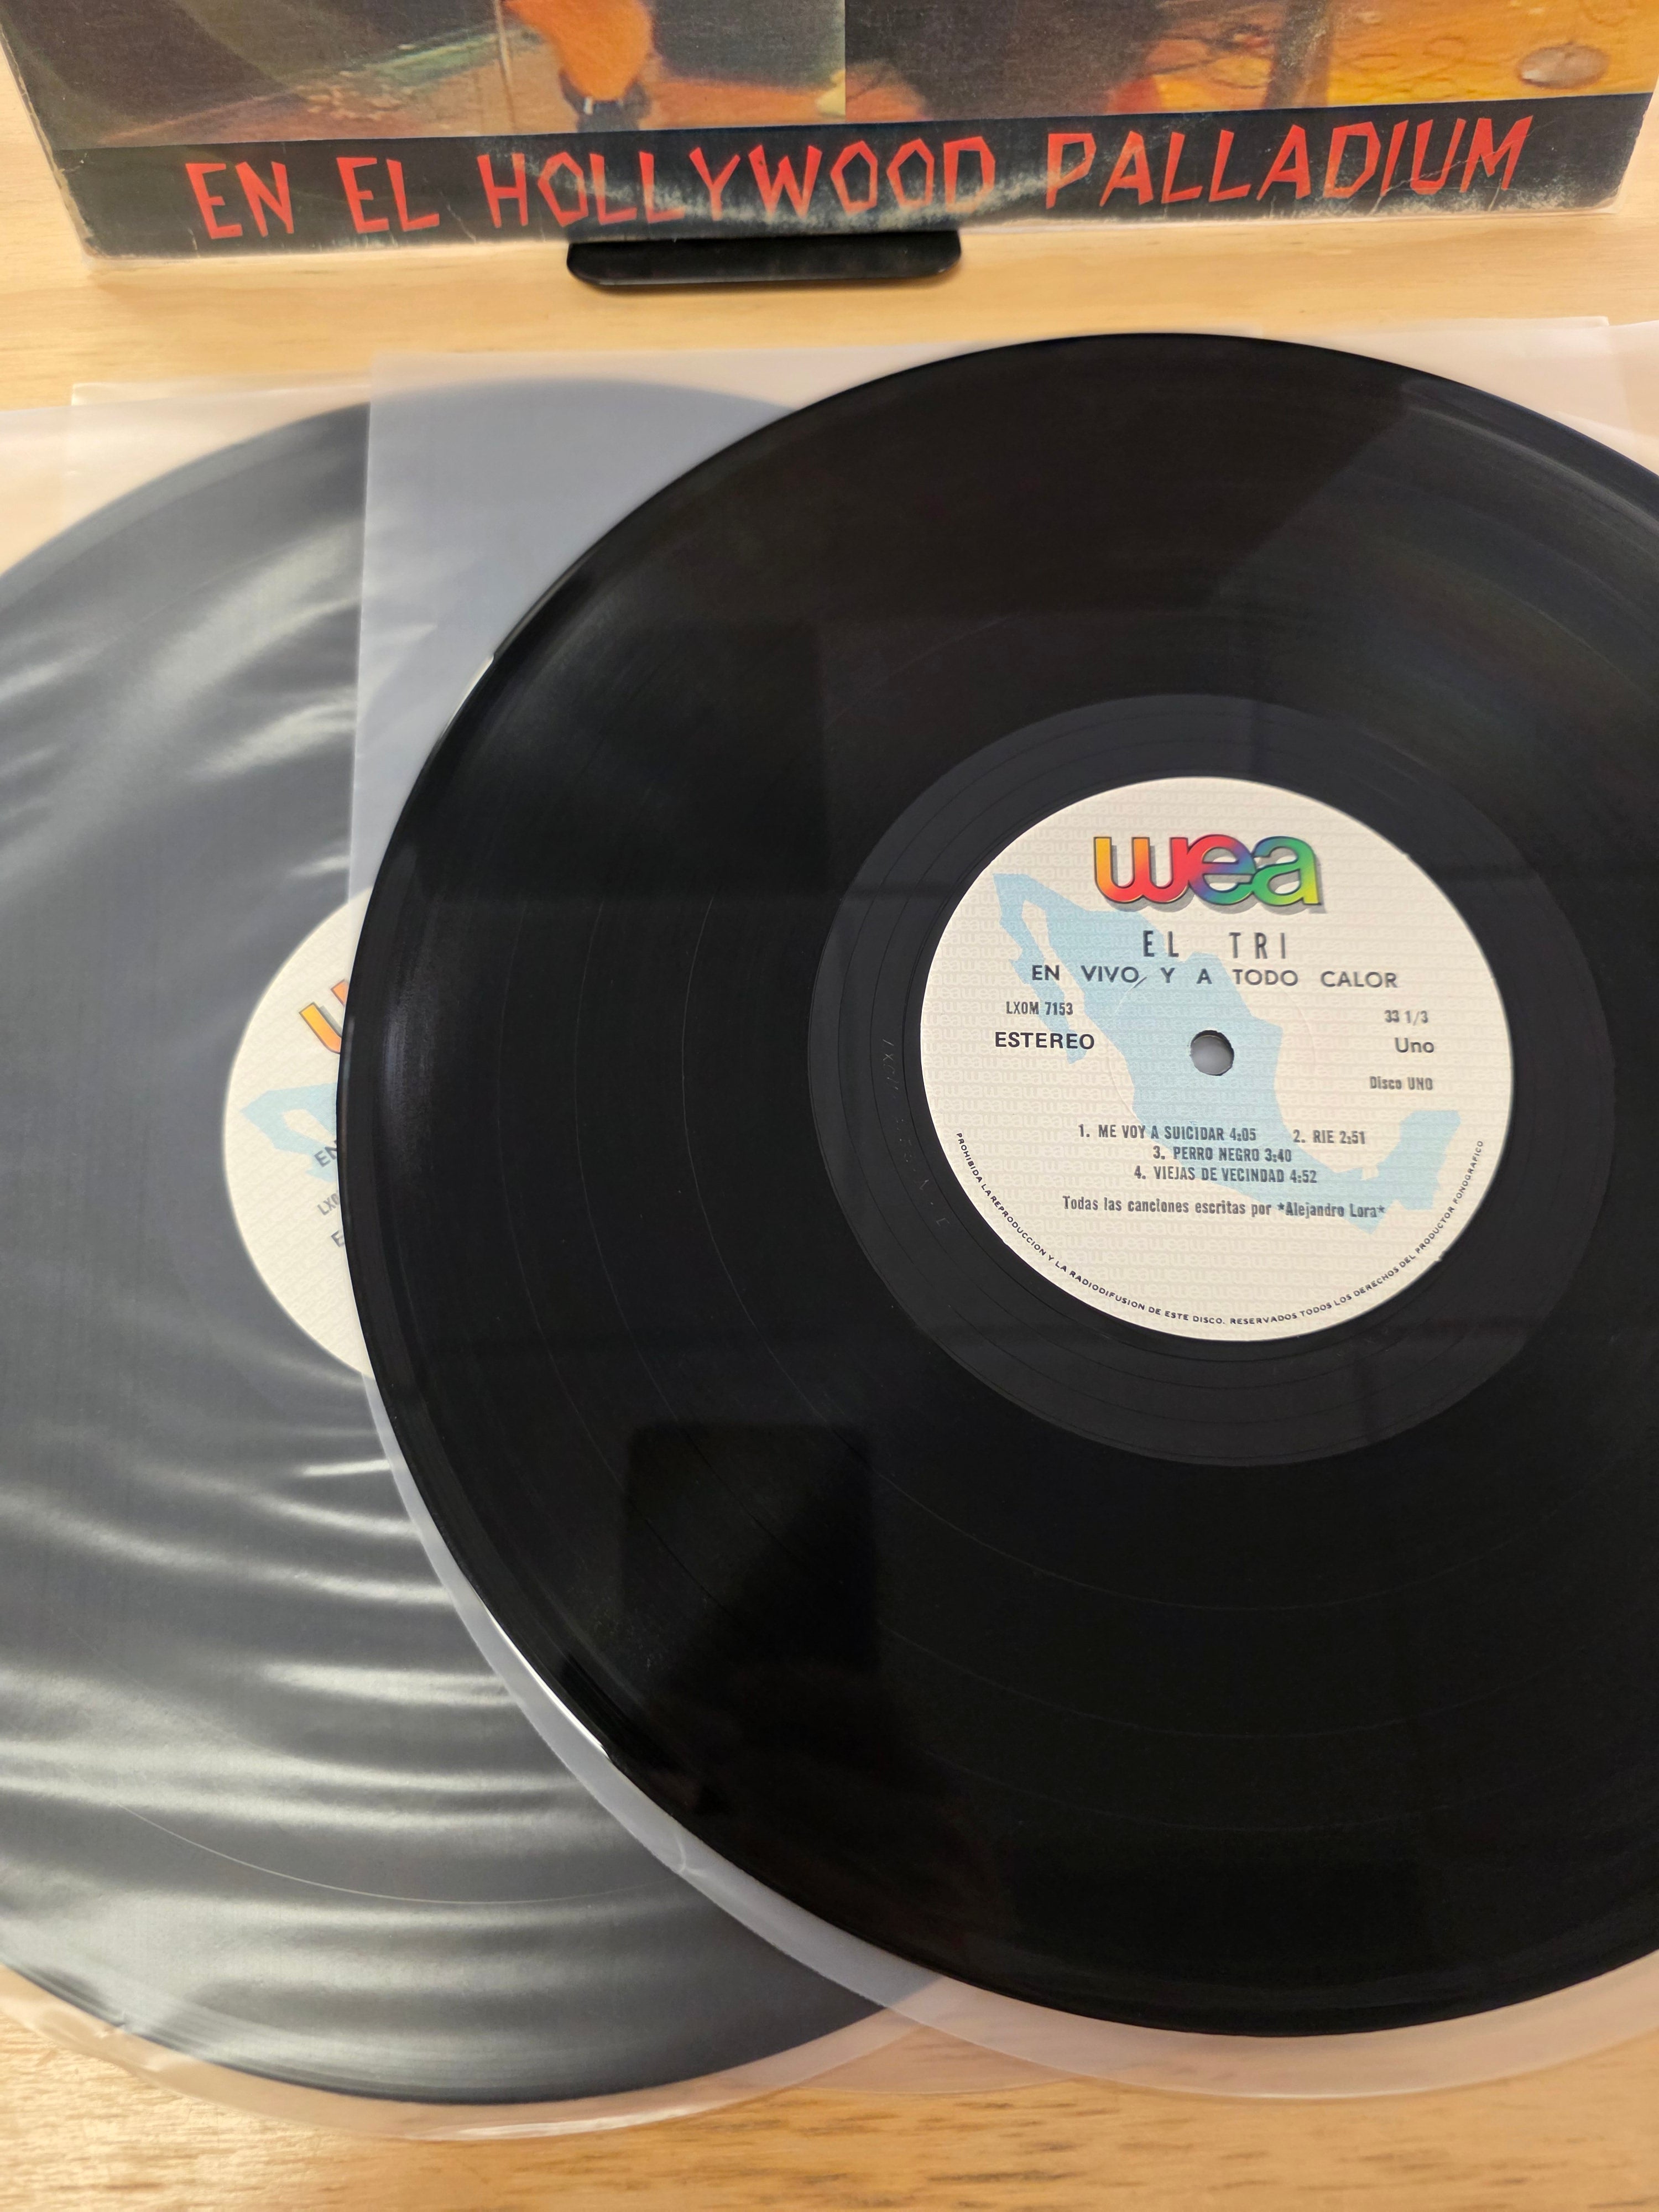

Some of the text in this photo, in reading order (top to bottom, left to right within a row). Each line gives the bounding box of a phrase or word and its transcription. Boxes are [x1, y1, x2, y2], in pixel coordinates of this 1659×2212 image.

[186, 114, 1534, 239] EN EL HOLLYWOOD PALLADIUM
[1093, 834, 1322, 907] wea
[1143, 930, 1286, 959] EL TRI
[1032, 964, 1397, 988] EN VIVO Y A TODO CALOR
[1045, 1001, 1073, 1016] 7153
[1385, 1010, 1429, 1026] 33 1/3
[995, 1031, 1094, 1050] ESTEREO
[1394, 1037, 1434, 1053] Uno
[1369, 1076, 1433, 1091] Disco UNO
[1078, 1123, 1365, 1144] 1. ME VOY A SUICIDAR 4:05 2. RIE 2:51
[1152, 1145, 1292, 1162] 3. PERRO NEGRO 3:40
[1134, 1165, 1317, 1183] 4. VIEJAS DE VECINDAD 4:52
[1062, 1195, 1098, 1211] Todas
[1104, 1197, 1122, 1211] las
[1128, 1198, 1189, 1212] canciones
[1195, 1200, 1245, 1214] escritas
[1251, 1203, 1271, 1217] por
[956, 1133, 983, 1183] PROHIBIDA
[981, 1183, 992, 1196] LA
[990, 1196, 1046, 1256] REPRODUCCION
[1055, 1261, 1067, 1272] LA
[1070, 1271, 1145, 1310] RADIODIFUSION
[1148, 1307, 1161, 1315] DE
[1165, 1311, 1189, 1321] ESTE
[1193, 1316, 1225, 1324] DISCO.
[1230, 1312, 1297, 1325] RESERVADOS
[1300, 1302, 1332, 1317] TODOS
[1333, 1293, 1352, 1306] LOS
[1353, 1266, 1400, 1297] DERECHOS
[1399, 1254, 1417, 1268] DEL
[1415, 1206, 1455, 1254] PRODUCTOR
[1453, 1140, 1484, 1204] FONOGRAFICO
